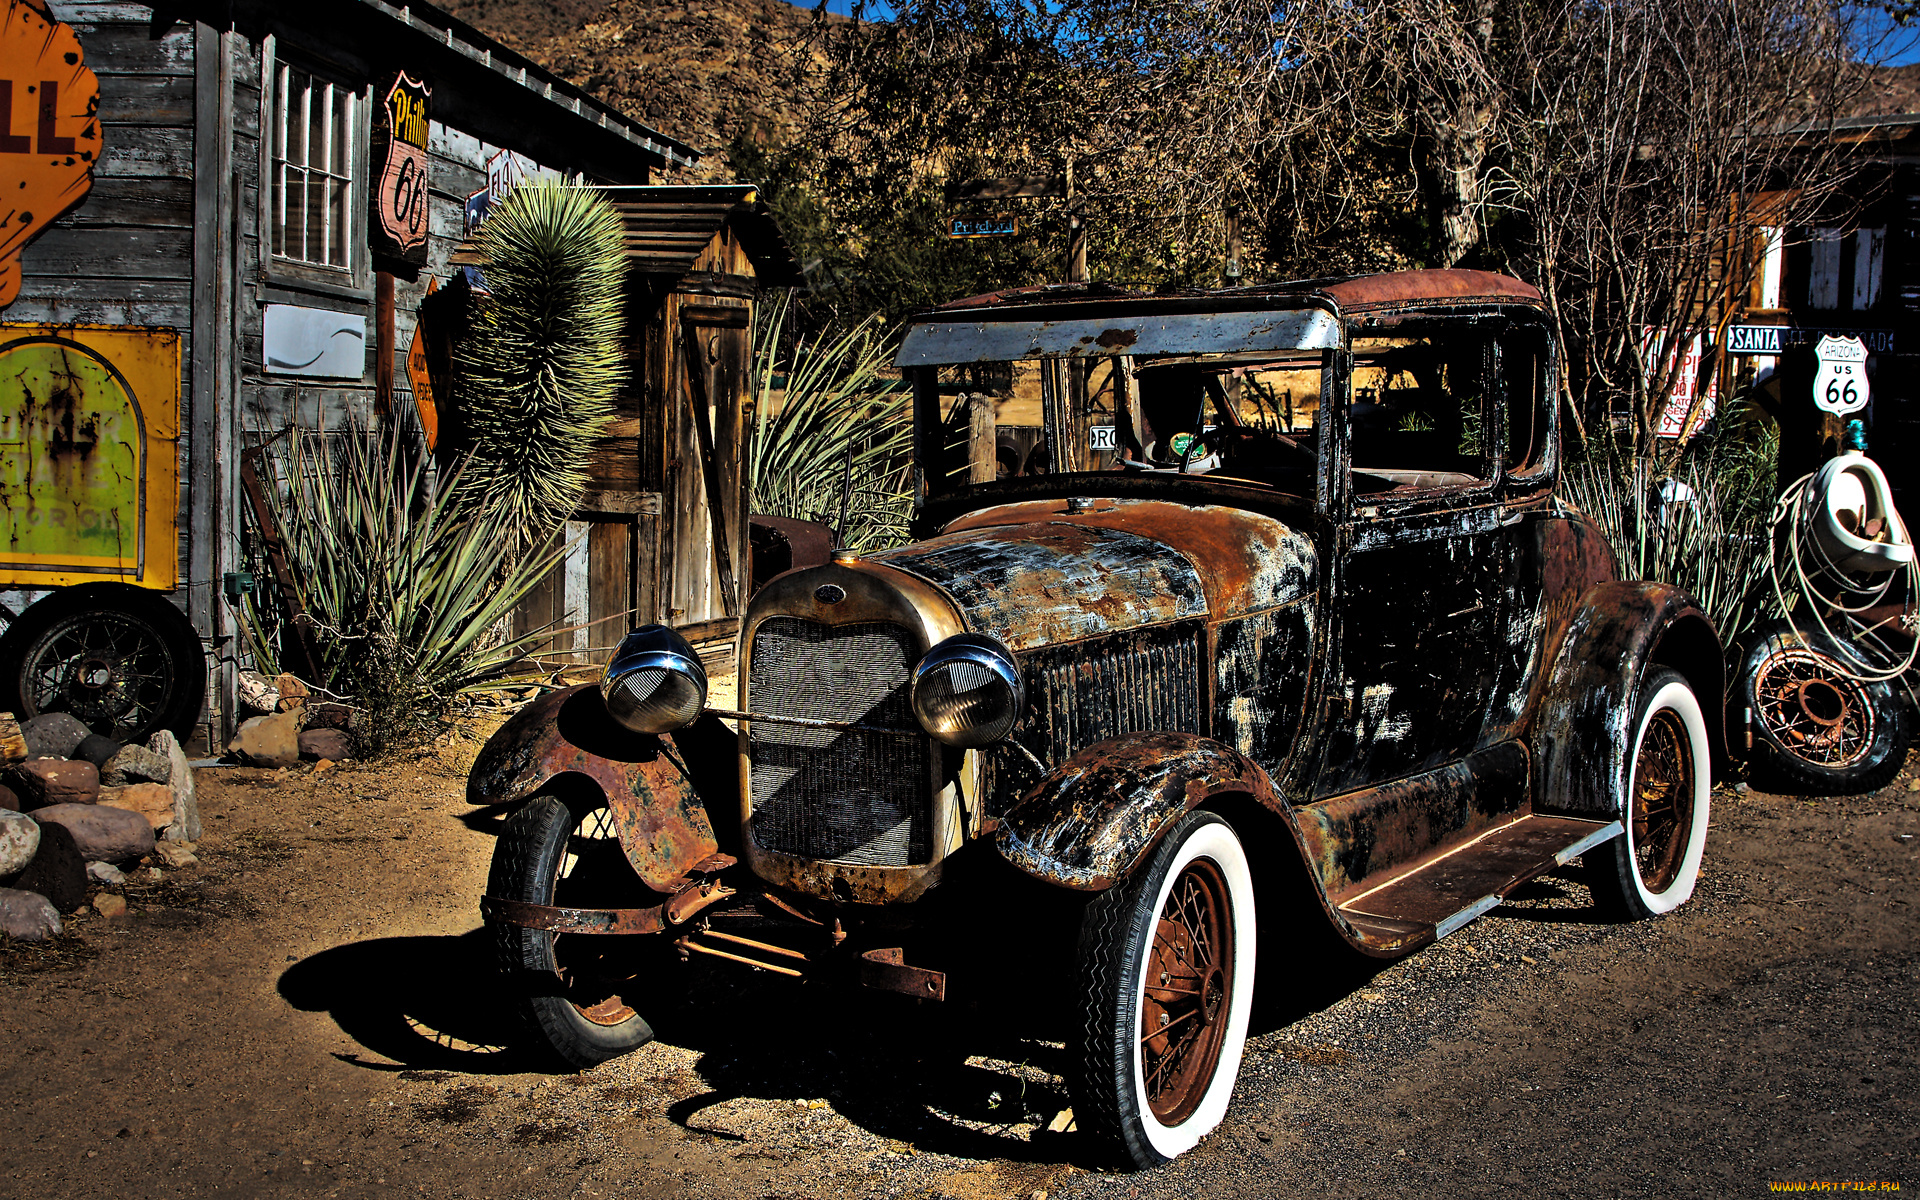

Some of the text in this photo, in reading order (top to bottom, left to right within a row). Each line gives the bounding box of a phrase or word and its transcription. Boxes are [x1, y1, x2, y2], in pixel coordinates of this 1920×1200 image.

[395, 157, 425, 235] 66
[1735, 328, 1780, 350] SANTA
[1825, 345, 1861, 358] ARIZONA
[1826, 378, 1858, 404] 66
